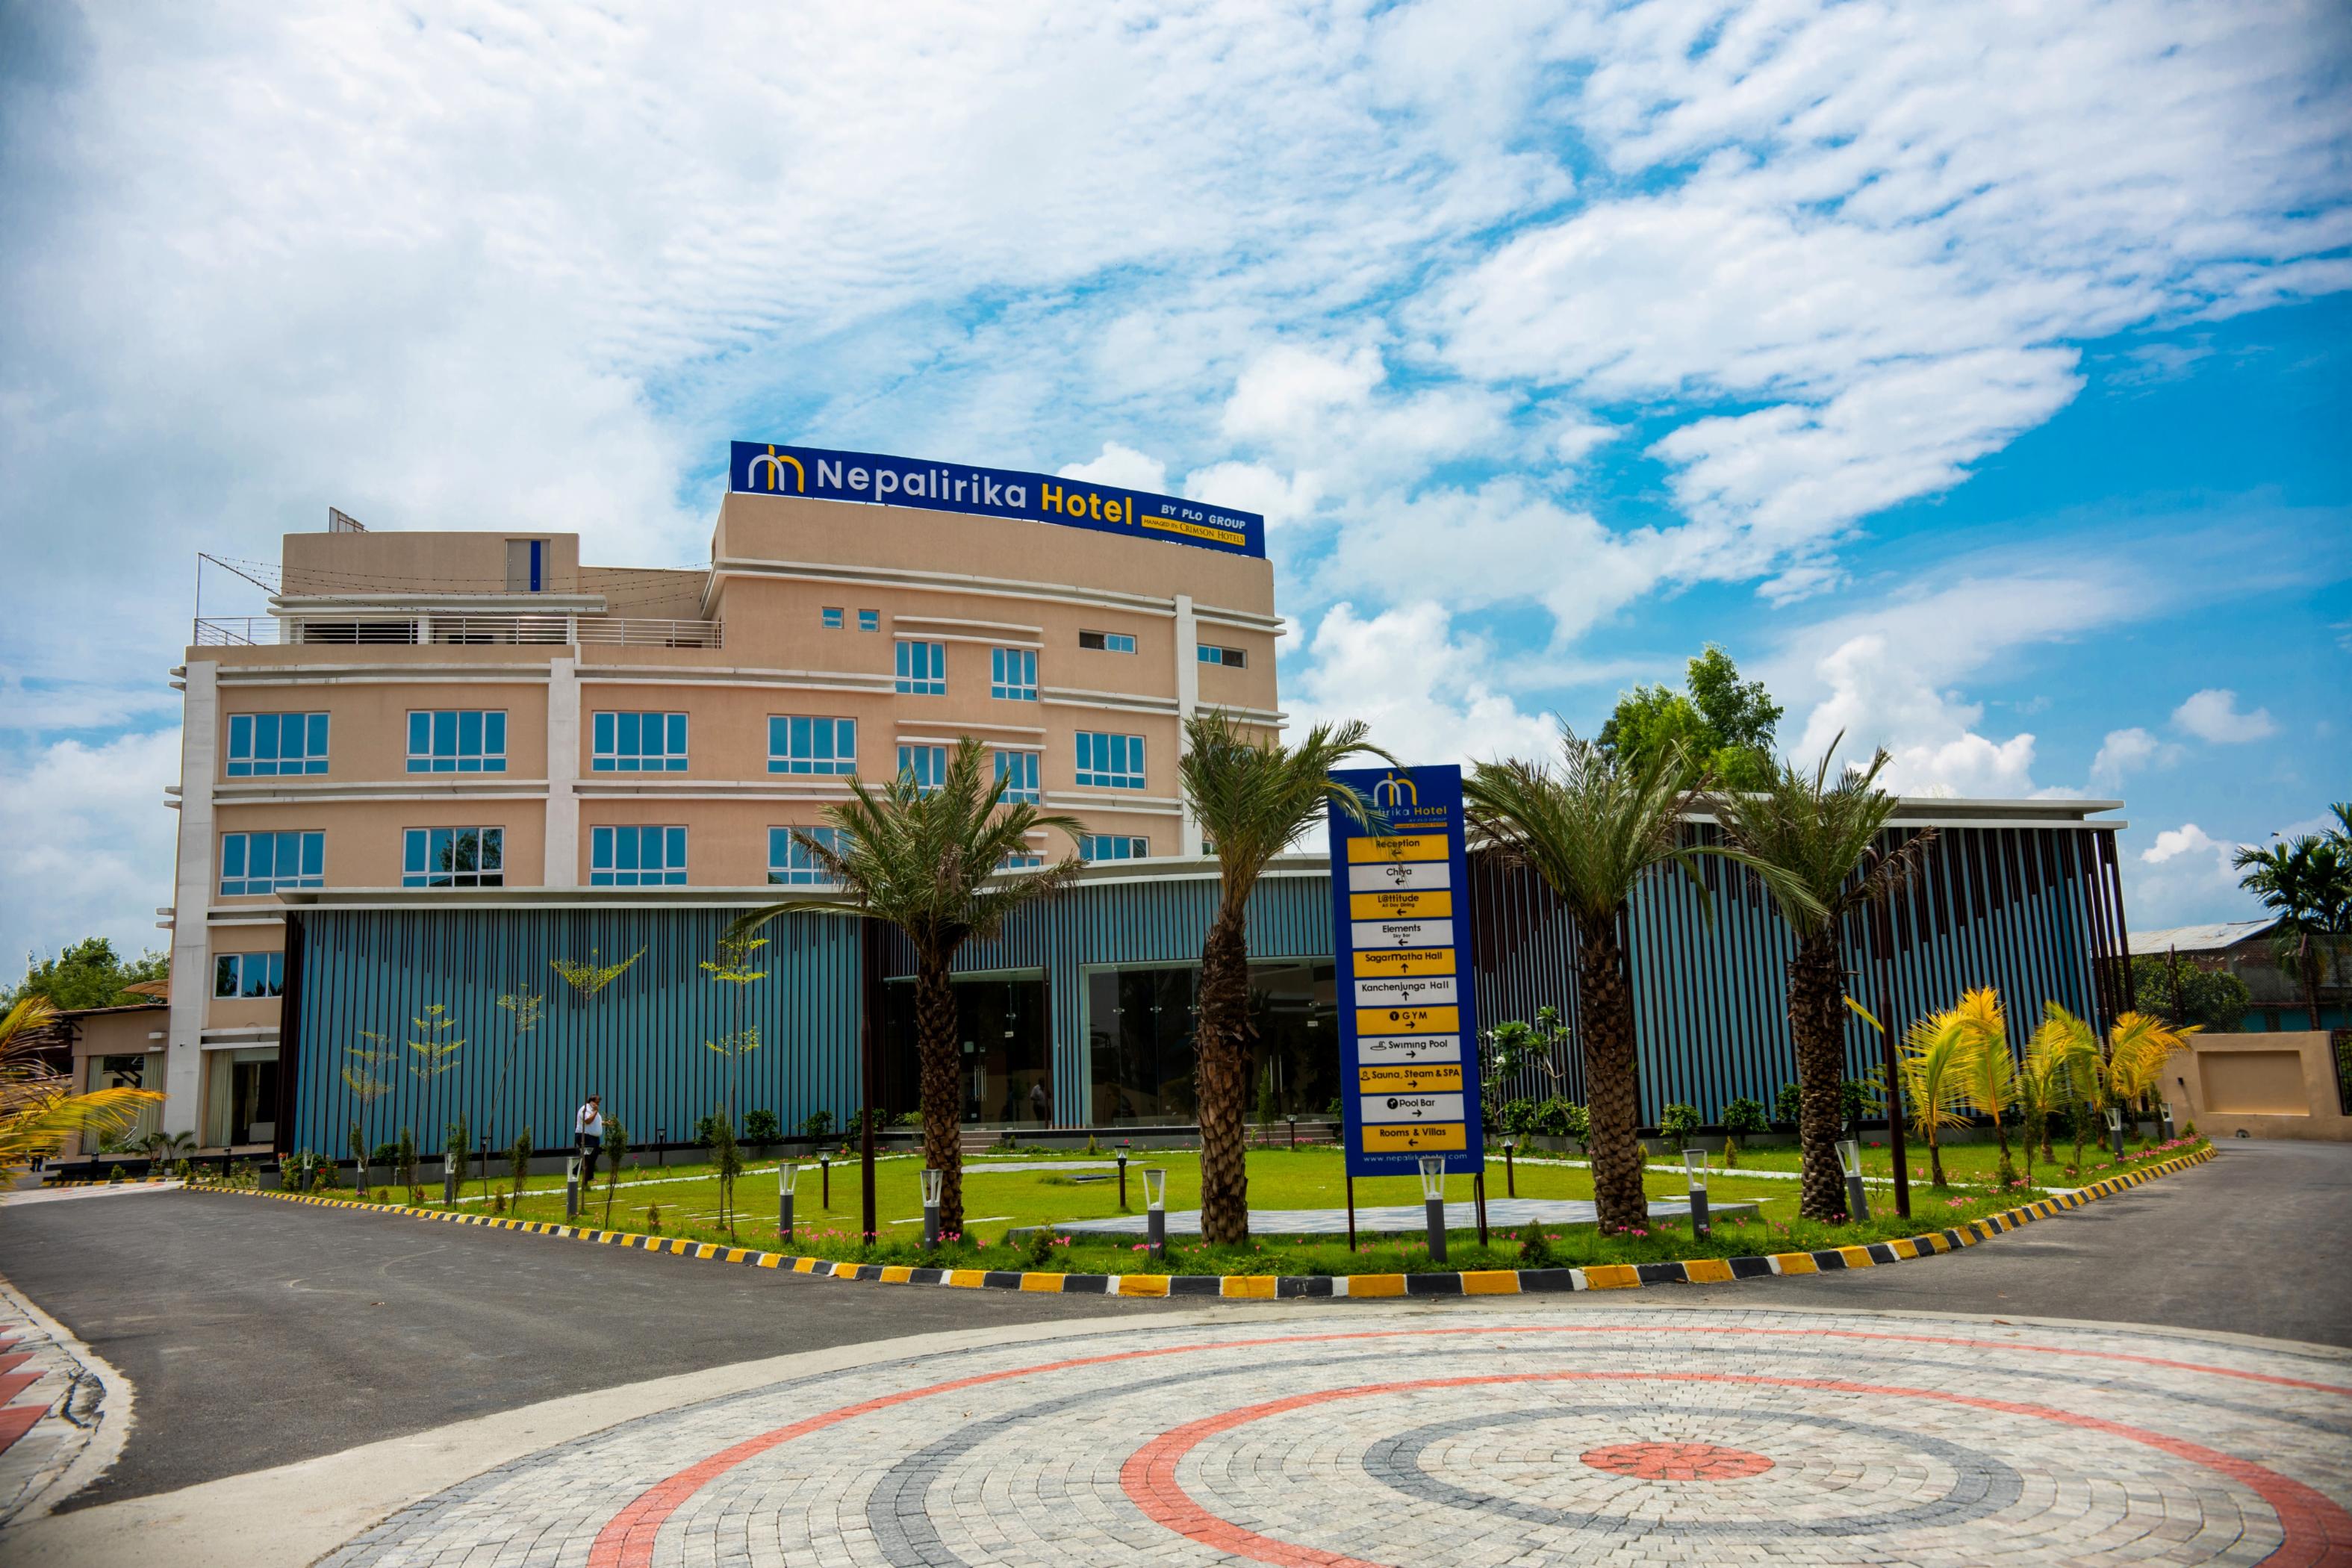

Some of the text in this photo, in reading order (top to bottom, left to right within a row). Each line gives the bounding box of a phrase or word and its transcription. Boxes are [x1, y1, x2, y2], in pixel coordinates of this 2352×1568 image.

[818, 458, 1133, 525] Nepalirika Hotel
[1161, 504, 1246, 529] BY PLO GROUP
[1414, 806, 1447, 815] Hotel
[1376, 839, 1420, 849] Reception
[1378, 894, 1419, 903] L@ttitude
[1382, 924, 1421, 933] Elements
[1425, 952, 1443, 960] Hall
[1362, 981, 1449, 992] Kanchenjunga Hall
[1402, 1011, 1428, 1020] GYM
[1388, 1039, 1448, 1050] Swiming Pool
[1372, 1068, 1460, 1080] Sauna, Steam & SPA
[1399, 1098, 1435, 1107] Pool Bar
[1413, 1128, 1419, 1136] &
[1422, 1127, 1446, 1136] Villas
